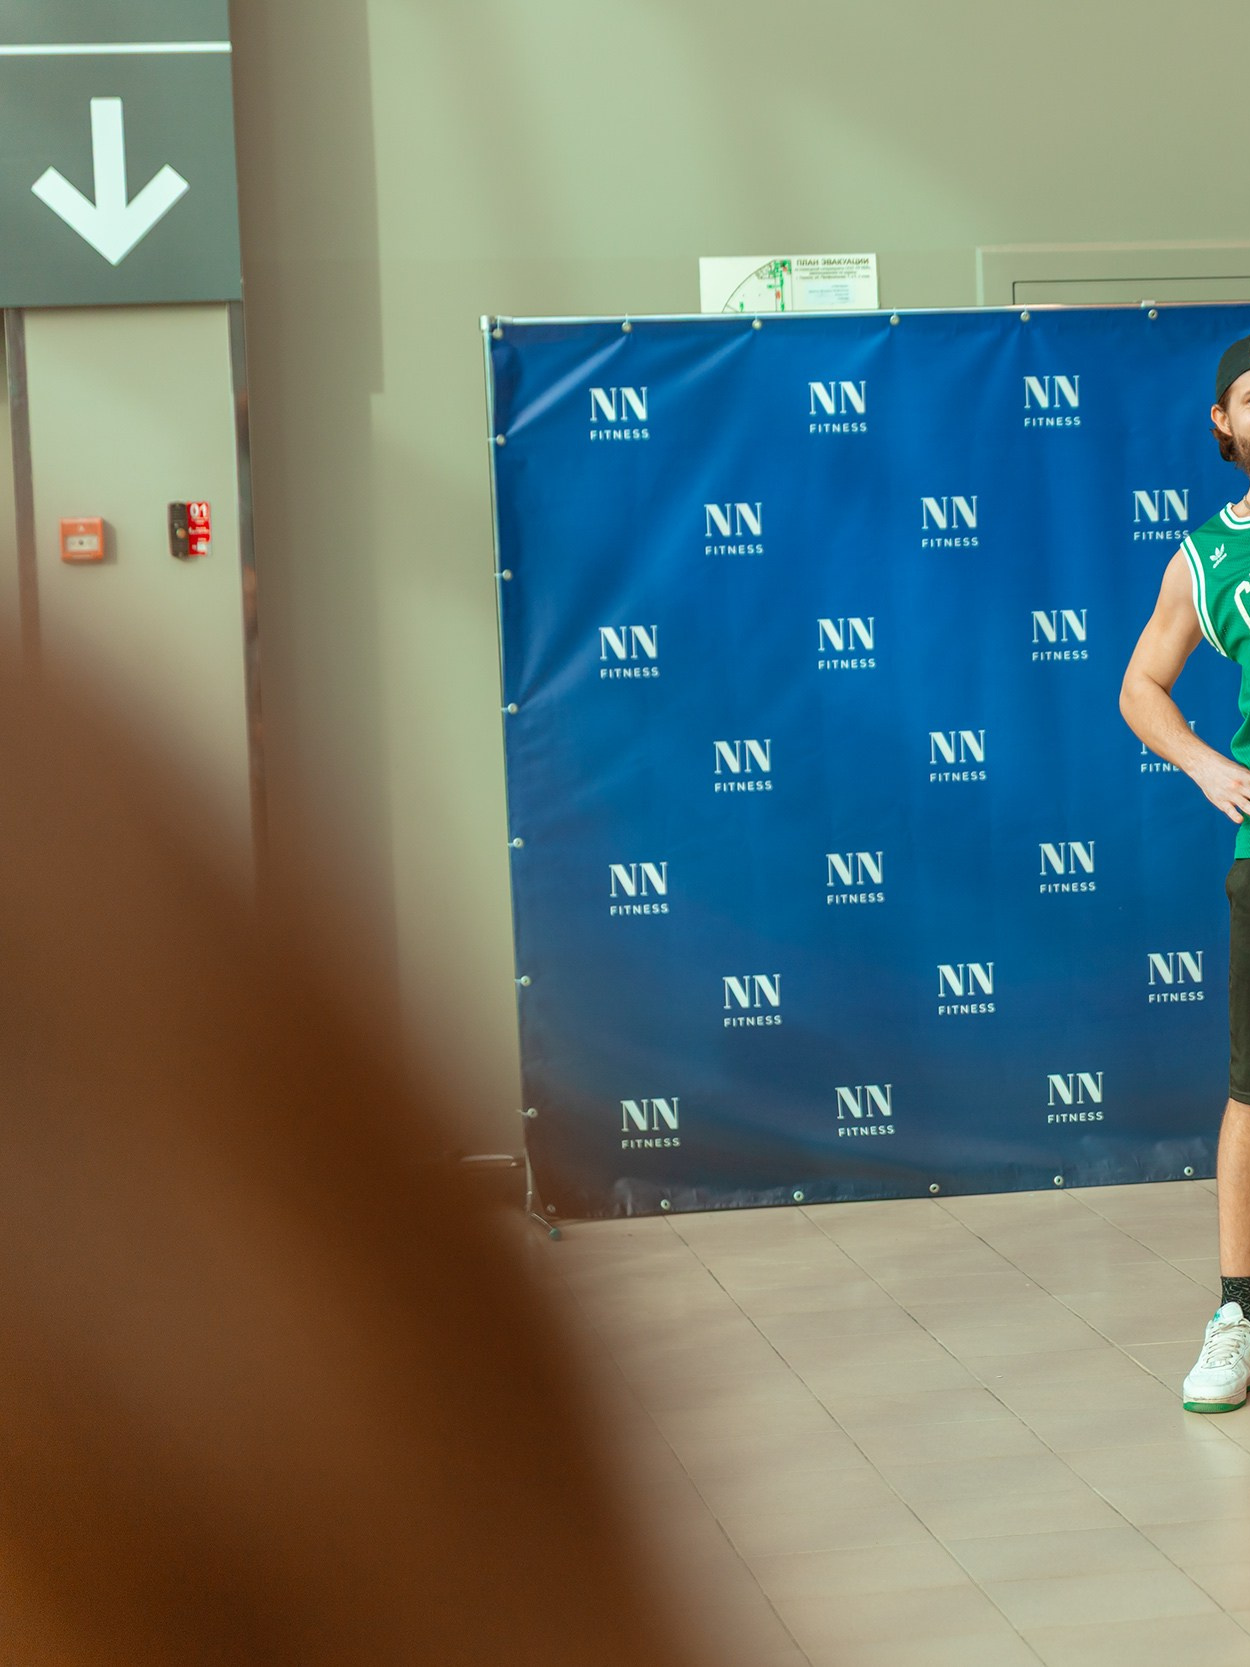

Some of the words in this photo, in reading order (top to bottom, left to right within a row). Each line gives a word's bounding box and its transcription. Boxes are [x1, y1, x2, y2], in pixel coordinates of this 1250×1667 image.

[796, 259, 819, 267] ПЛАН
[821, 257, 869, 266] ЭВАКУАЦИИ
[808, 381, 866, 415] NN
[1024, 375, 1079, 409] NN
[589, 387, 648, 422] NN
[809, 421, 868, 434] FITNESS
[1023, 415, 1081, 427] FITNESS
[589, 428, 650, 441] FITNESS
[190, 502, 207, 518] 01
[921, 496, 977, 529] NN
[1133, 489, 1189, 522] NN
[704, 502, 762, 537] NN
[704, 543, 765, 556] FITNESS
[921, 536, 979, 548] FITNESS
[1031, 609, 1087, 643] NN
[817, 617, 874, 652] NN
[598, 625, 657, 661] NN
[817, 657, 876, 670] FITNESS
[1031, 649, 1089, 662] FITNESS
[599, 666, 660, 680] FITNESS
[929, 730, 985, 764] NN
[713, 739, 771, 774] NN
[929, 770, 987, 783] FITNESS
[714, 779, 773, 793] FITNESS
[1039, 841, 1094, 875] NN
[826, 851, 883, 887] NN
[609, 861, 668, 897] NN
[1039, 881, 1097, 894] FITNESS
[826, 891, 886, 906] FITNESS
[609, 902, 670, 916] FITNESS
[1147, 951, 1203, 985] NN
[937, 962, 994, 997] NN
[723, 974, 780, 1009] NN
[1148, 991, 1205, 1004] FITNESS
[938, 1002, 996, 1016] FITNESS
[723, 1014, 782, 1028] FITNESS
[1047, 1072, 1103, 1105] NN
[835, 1084, 892, 1119] NN
[621, 1097, 678, 1131] NN
[1047, 1111, 1104, 1124] FITNESS
[837, 1124, 895, 1138] FITNESS
[621, 1137, 681, 1149] FITNESS
